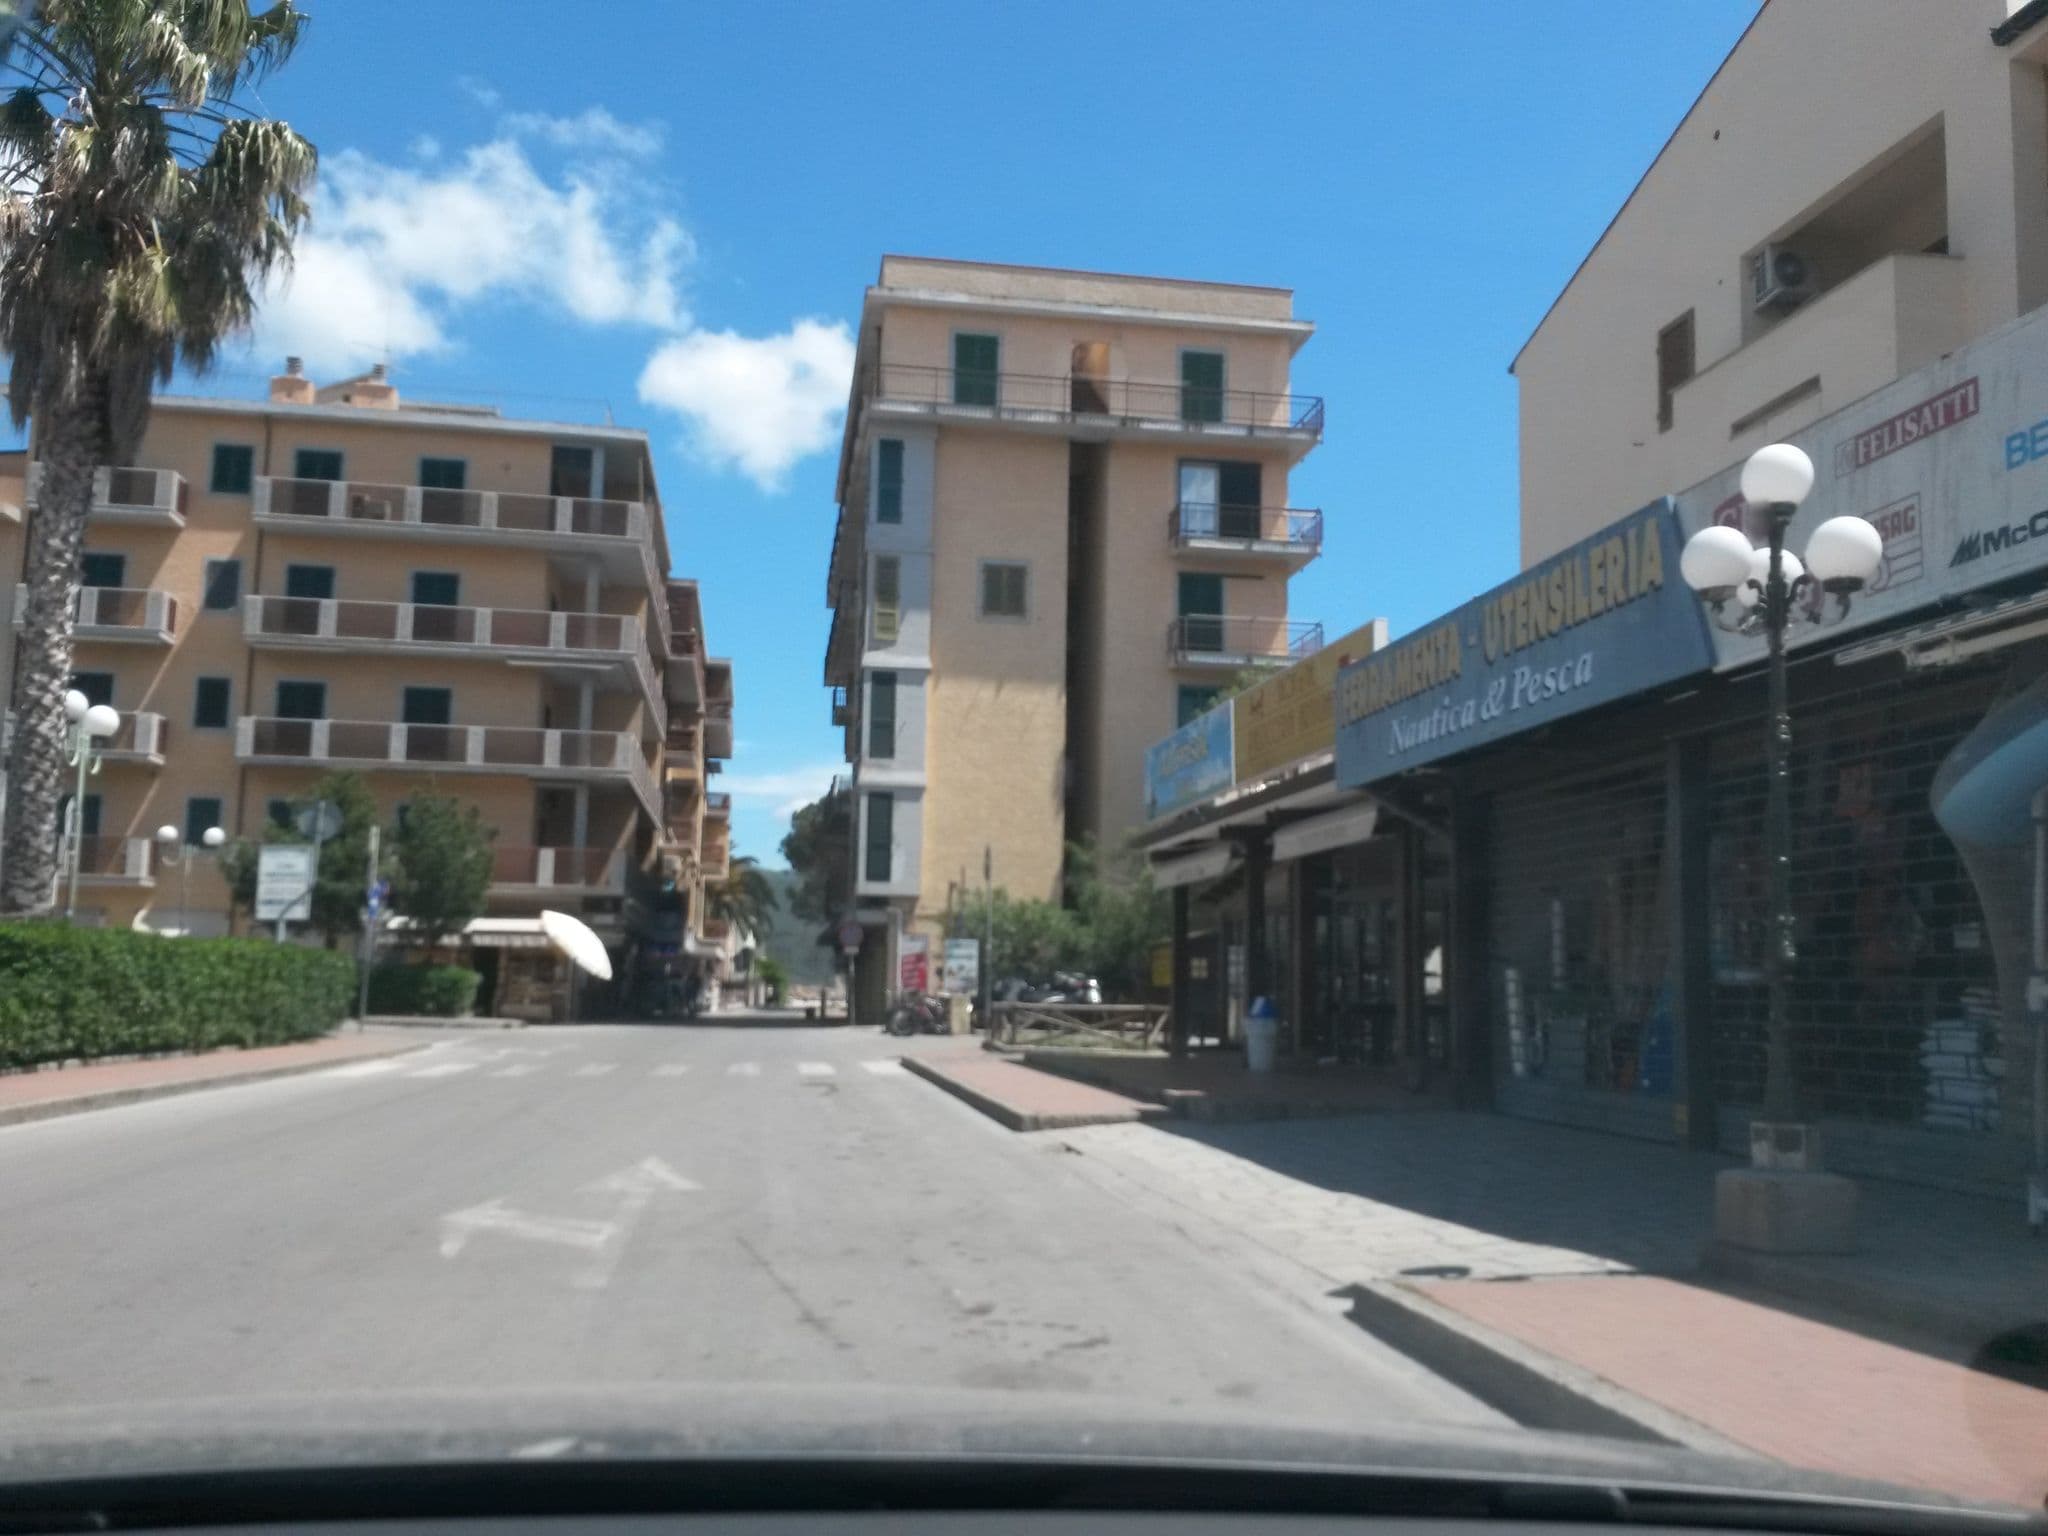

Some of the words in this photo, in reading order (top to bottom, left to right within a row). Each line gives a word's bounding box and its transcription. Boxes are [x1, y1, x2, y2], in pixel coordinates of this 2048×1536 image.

[1857, 383, 1977, 466] FELISATTI
[1342, 622, 1462, 727] FERRAMENTA
[1482, 518, 1664, 665] UTENSILERIA
[1388, 697, 1475, 757] Nautica
[1481, 676, 1504, 720] &
[1510, 651, 1594, 712] Pesca
